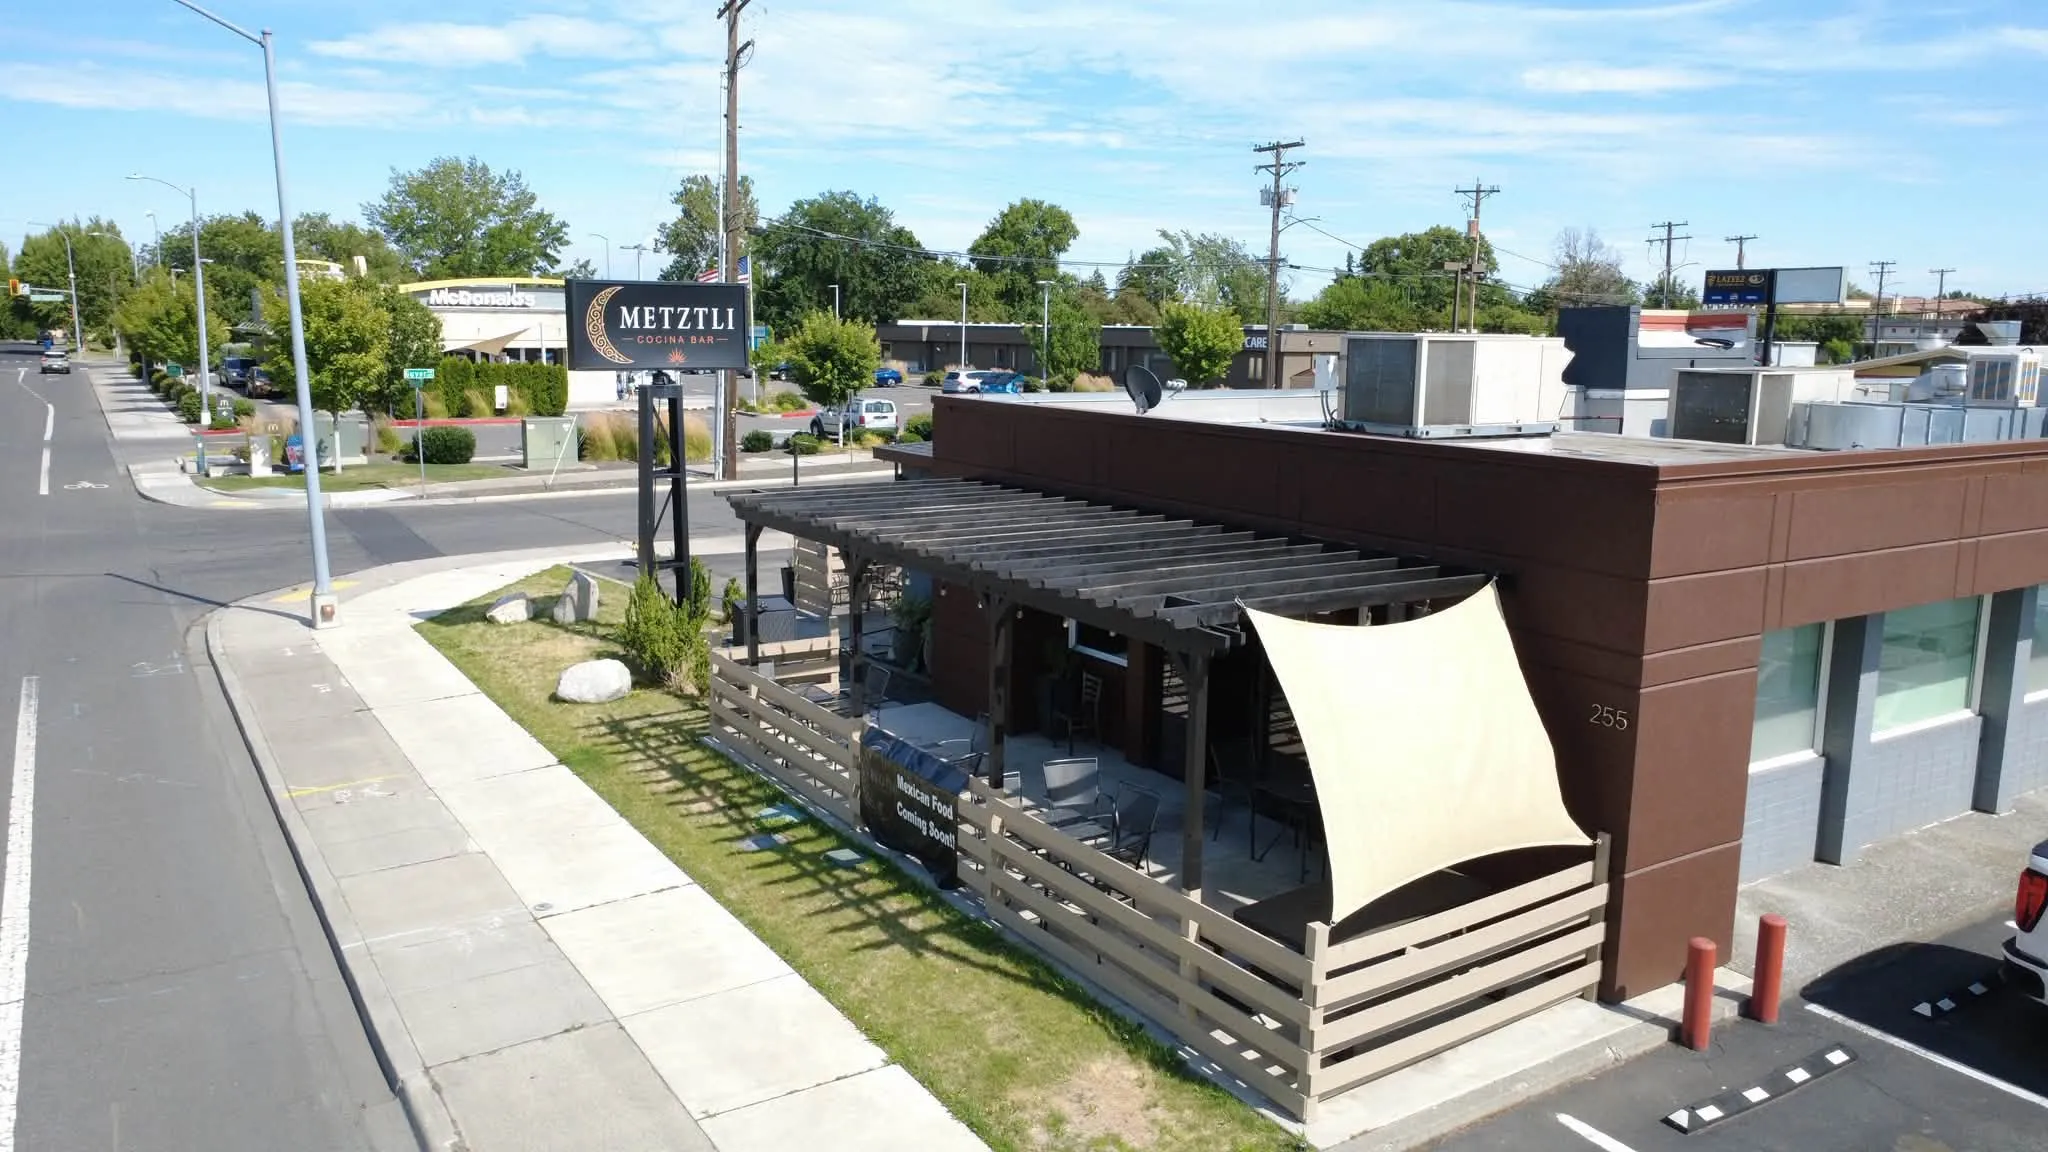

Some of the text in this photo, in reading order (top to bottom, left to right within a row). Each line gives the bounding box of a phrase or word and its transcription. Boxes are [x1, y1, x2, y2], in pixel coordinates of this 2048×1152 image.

[620, 306, 735, 329] METZTLI
[637, 336, 714, 345] COCINA BAR
[1245, 336, 1267, 348] CARE
[1590, 704, 1627, 730] 255
[896, 773, 954, 821] Mexican Food
[896, 801, 928, 836] Coming
